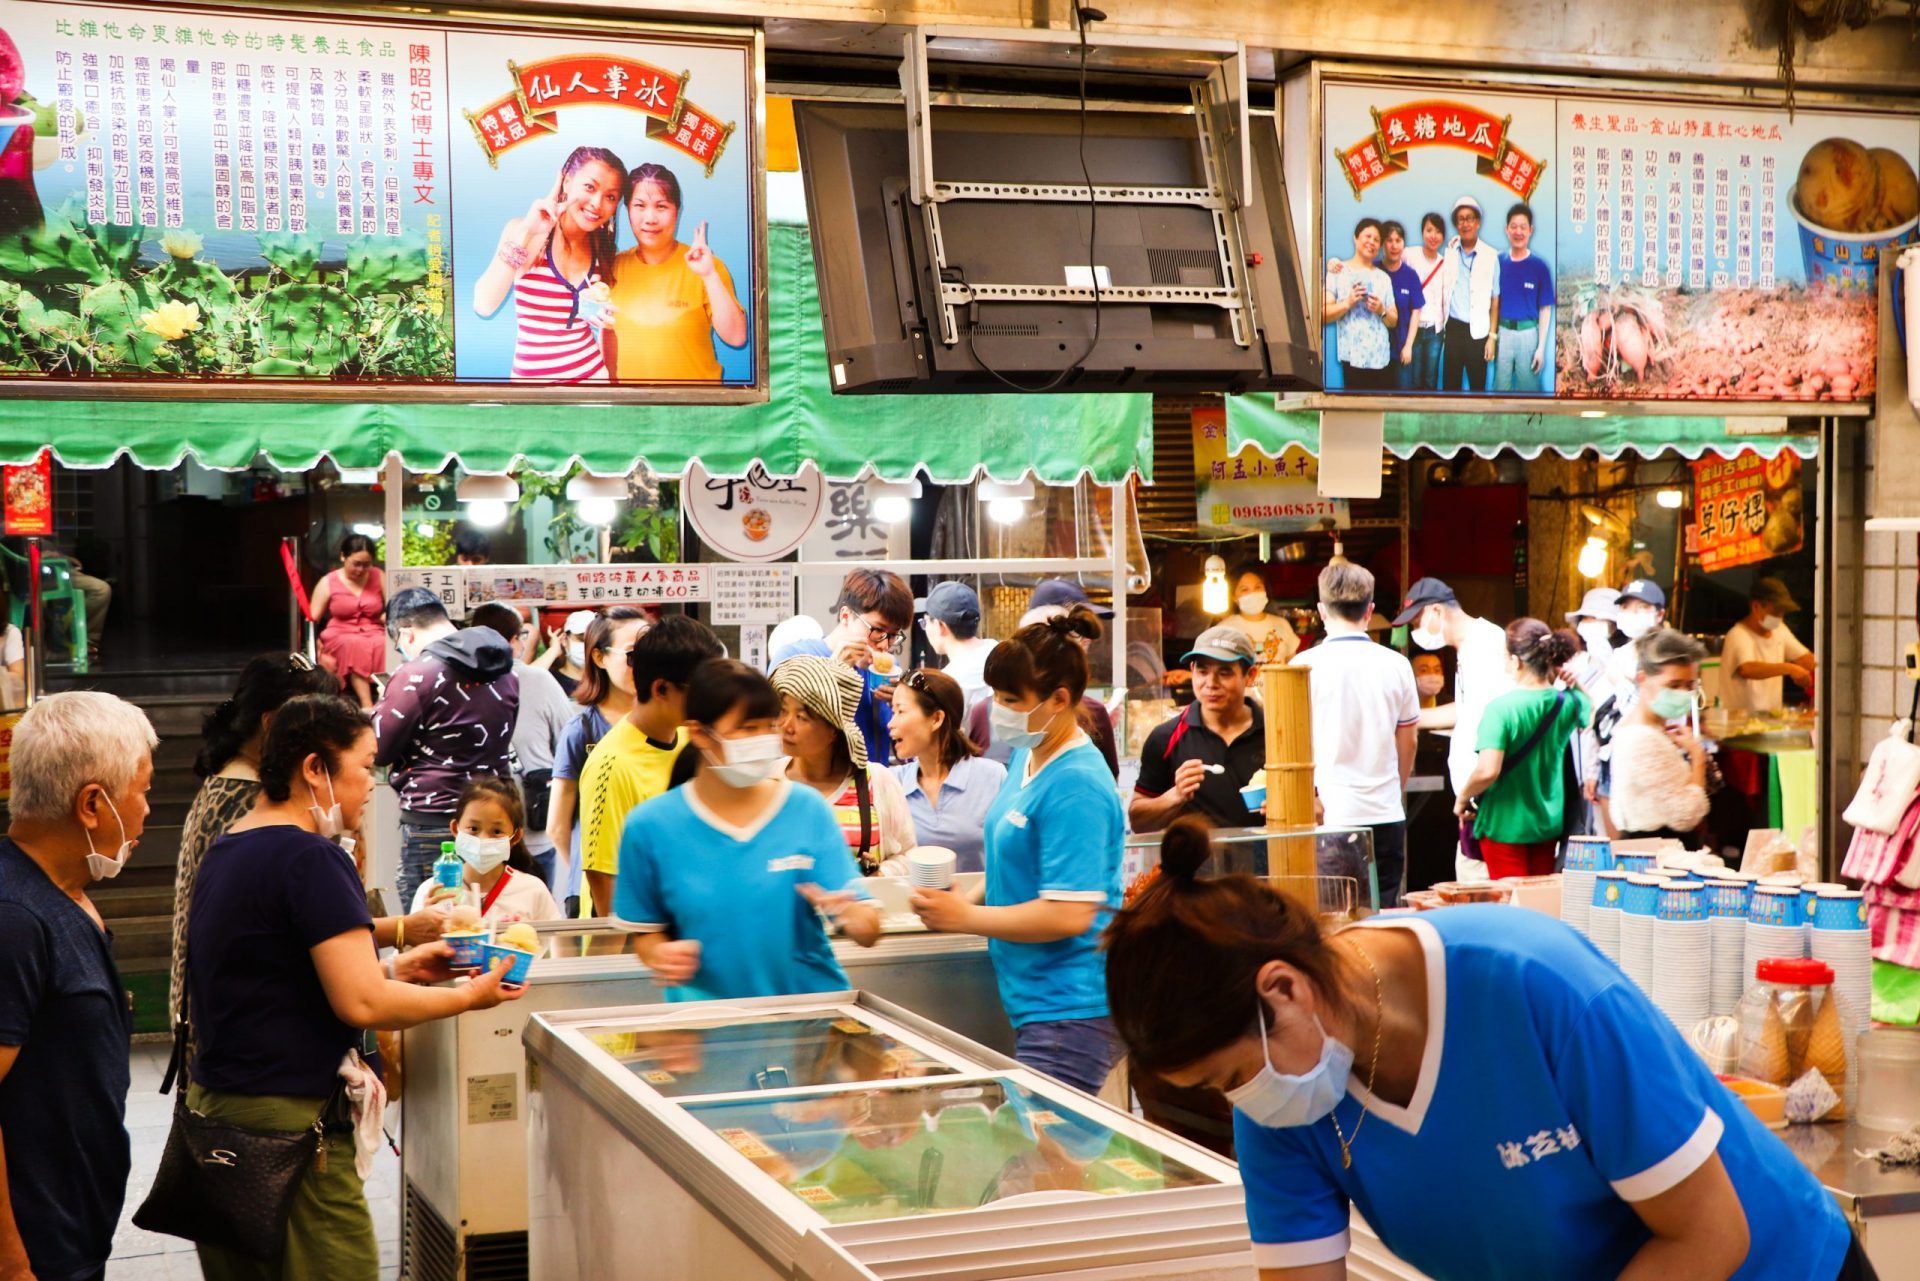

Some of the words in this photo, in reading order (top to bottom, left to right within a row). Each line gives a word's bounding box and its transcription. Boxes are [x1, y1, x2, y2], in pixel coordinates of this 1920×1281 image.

[55, 18, 397, 58] 比維他命更維他命的時髦養生食品
[529, 65, 669, 108] 仙人掌冰
[409, 43, 435, 205] 陳昭妃博士專文
[481, 105, 518, 133] 特製
[682, 111, 718, 142] 獨特
[1387, 113, 1494, 149] 焦糖地瓜
[489, 123, 527, 149] 冰品
[674, 129, 710, 157] 風味
[1348, 144, 1377, 170] 特製
[1504, 151, 1533, 178] 創始
[1356, 160, 1385, 184] 冰品
[1500, 165, 1527, 192] 老店
[1203, 422, 1227, 438] 金
[1211, 456, 1319, 480] 阿孟小魚干
[1232, 502, 1335, 519] 0963068571
[1700, 493, 1766, 543] 草仔粿
[421, 572, 453, 588] 手工
